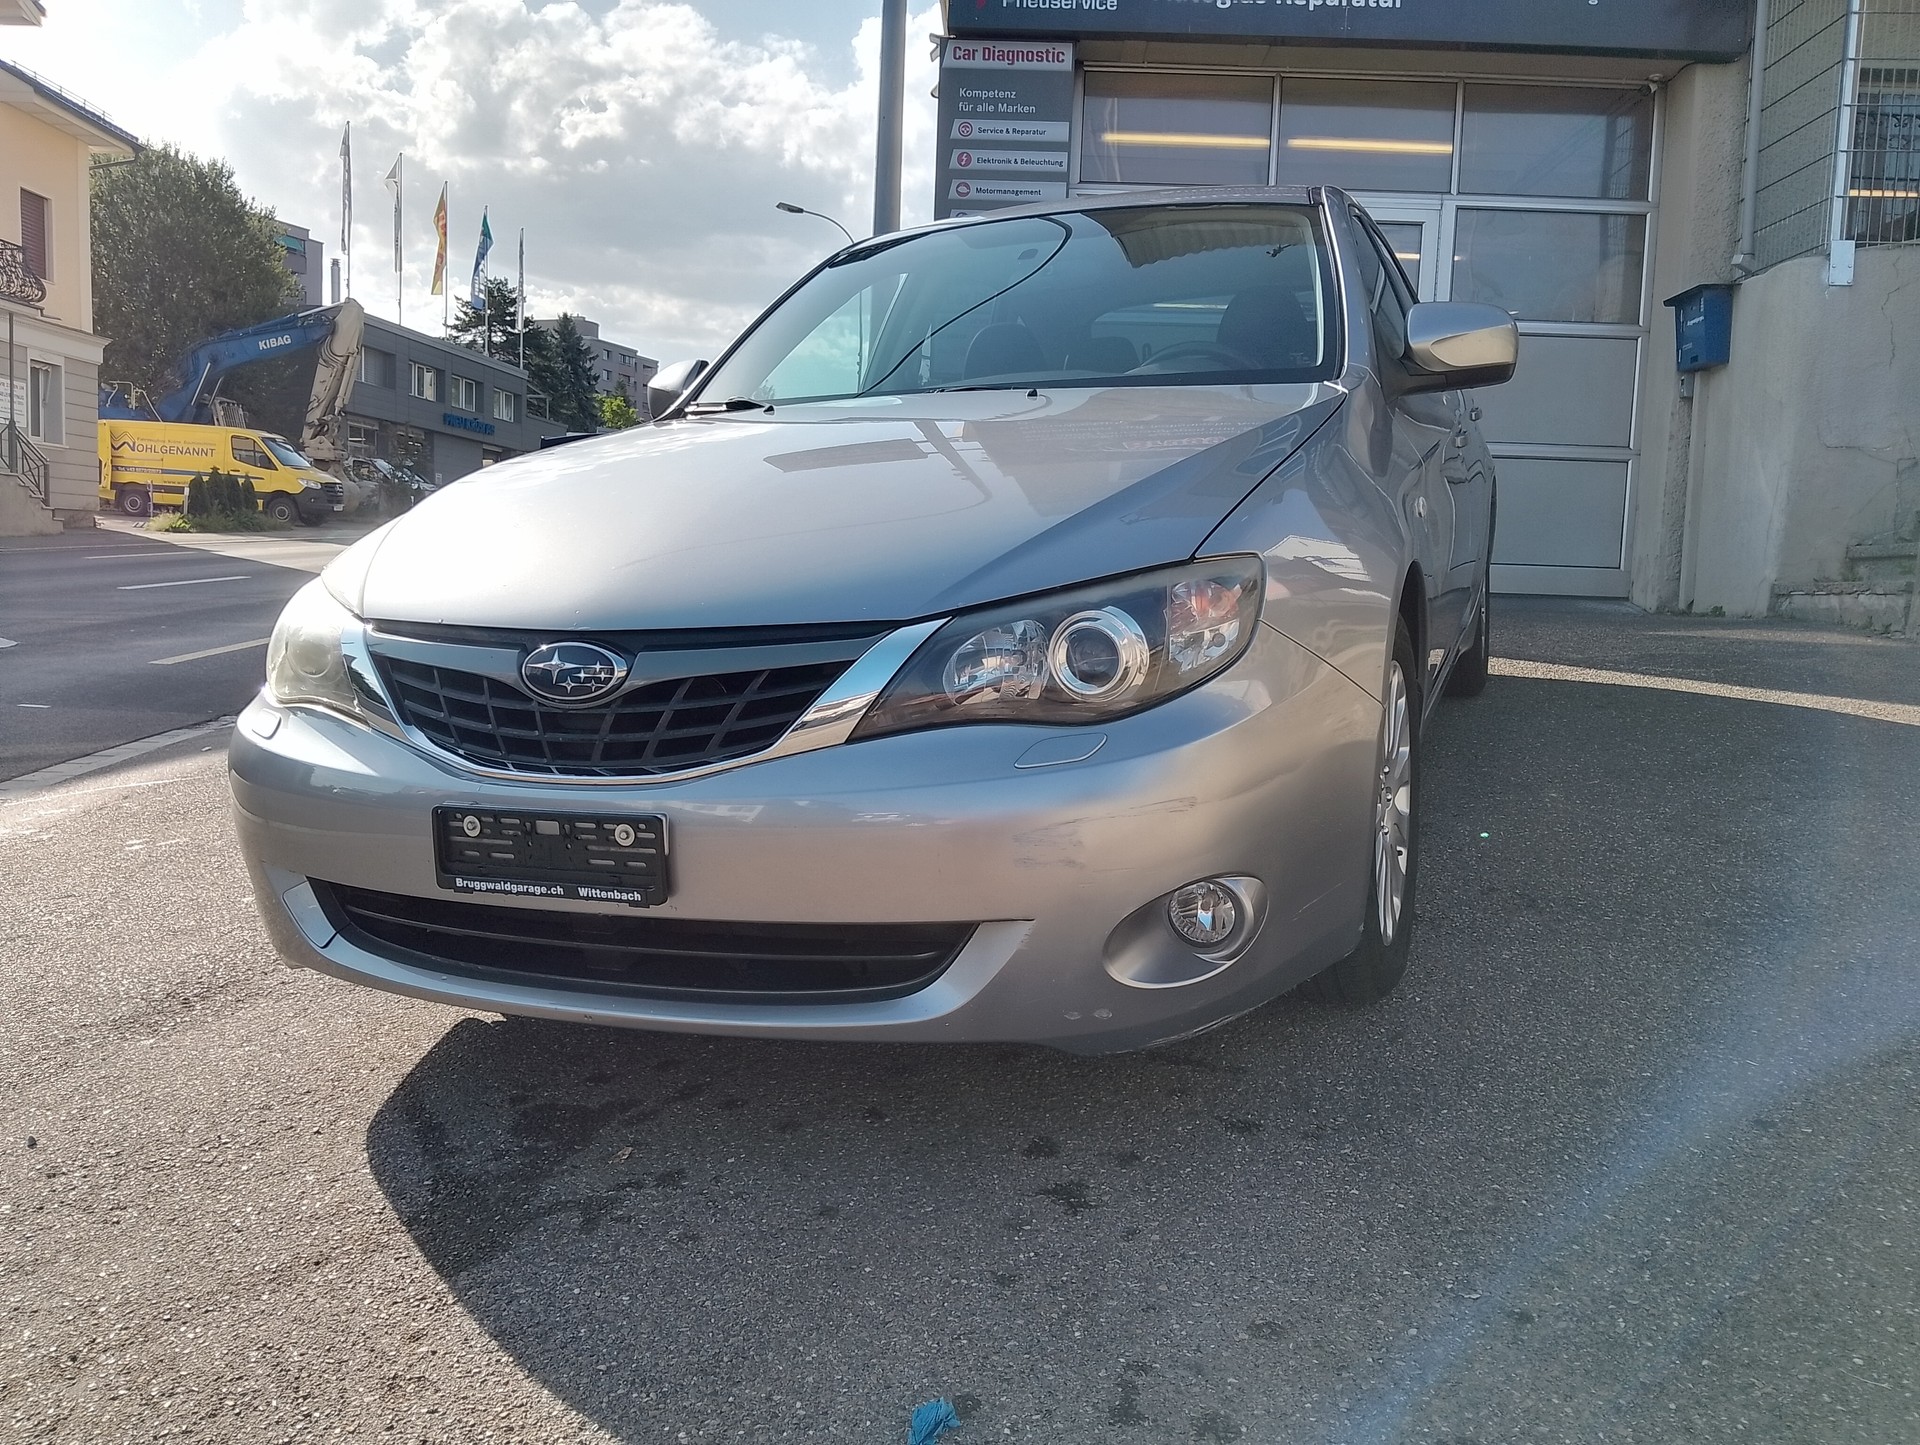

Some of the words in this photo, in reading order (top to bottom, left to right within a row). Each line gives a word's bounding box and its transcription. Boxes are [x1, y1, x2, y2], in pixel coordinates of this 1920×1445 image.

[952, 46, 978, 61] Car
[982, 45, 1065, 66] Diagnostic
[959, 87, 1016, 100] Kompetenz
[958, 101, 973, 112] für
[976, 102, 994, 113] alle
[998, 103, 1036, 114] Marken
[977, 126, 1004, 135] Service
[1012, 127, 1047, 137] Reparatur
[976, 156, 1012, 165] Elektronik
[1020, 158, 1064, 168] Beleuchtung
[975, 186, 1041, 197] Motormanagement
[258, 334, 292, 351] KIBAG
[455, 877, 564, 896] Bruggwaldgarage.ch
[577, 886, 642, 901] Wittenbach
